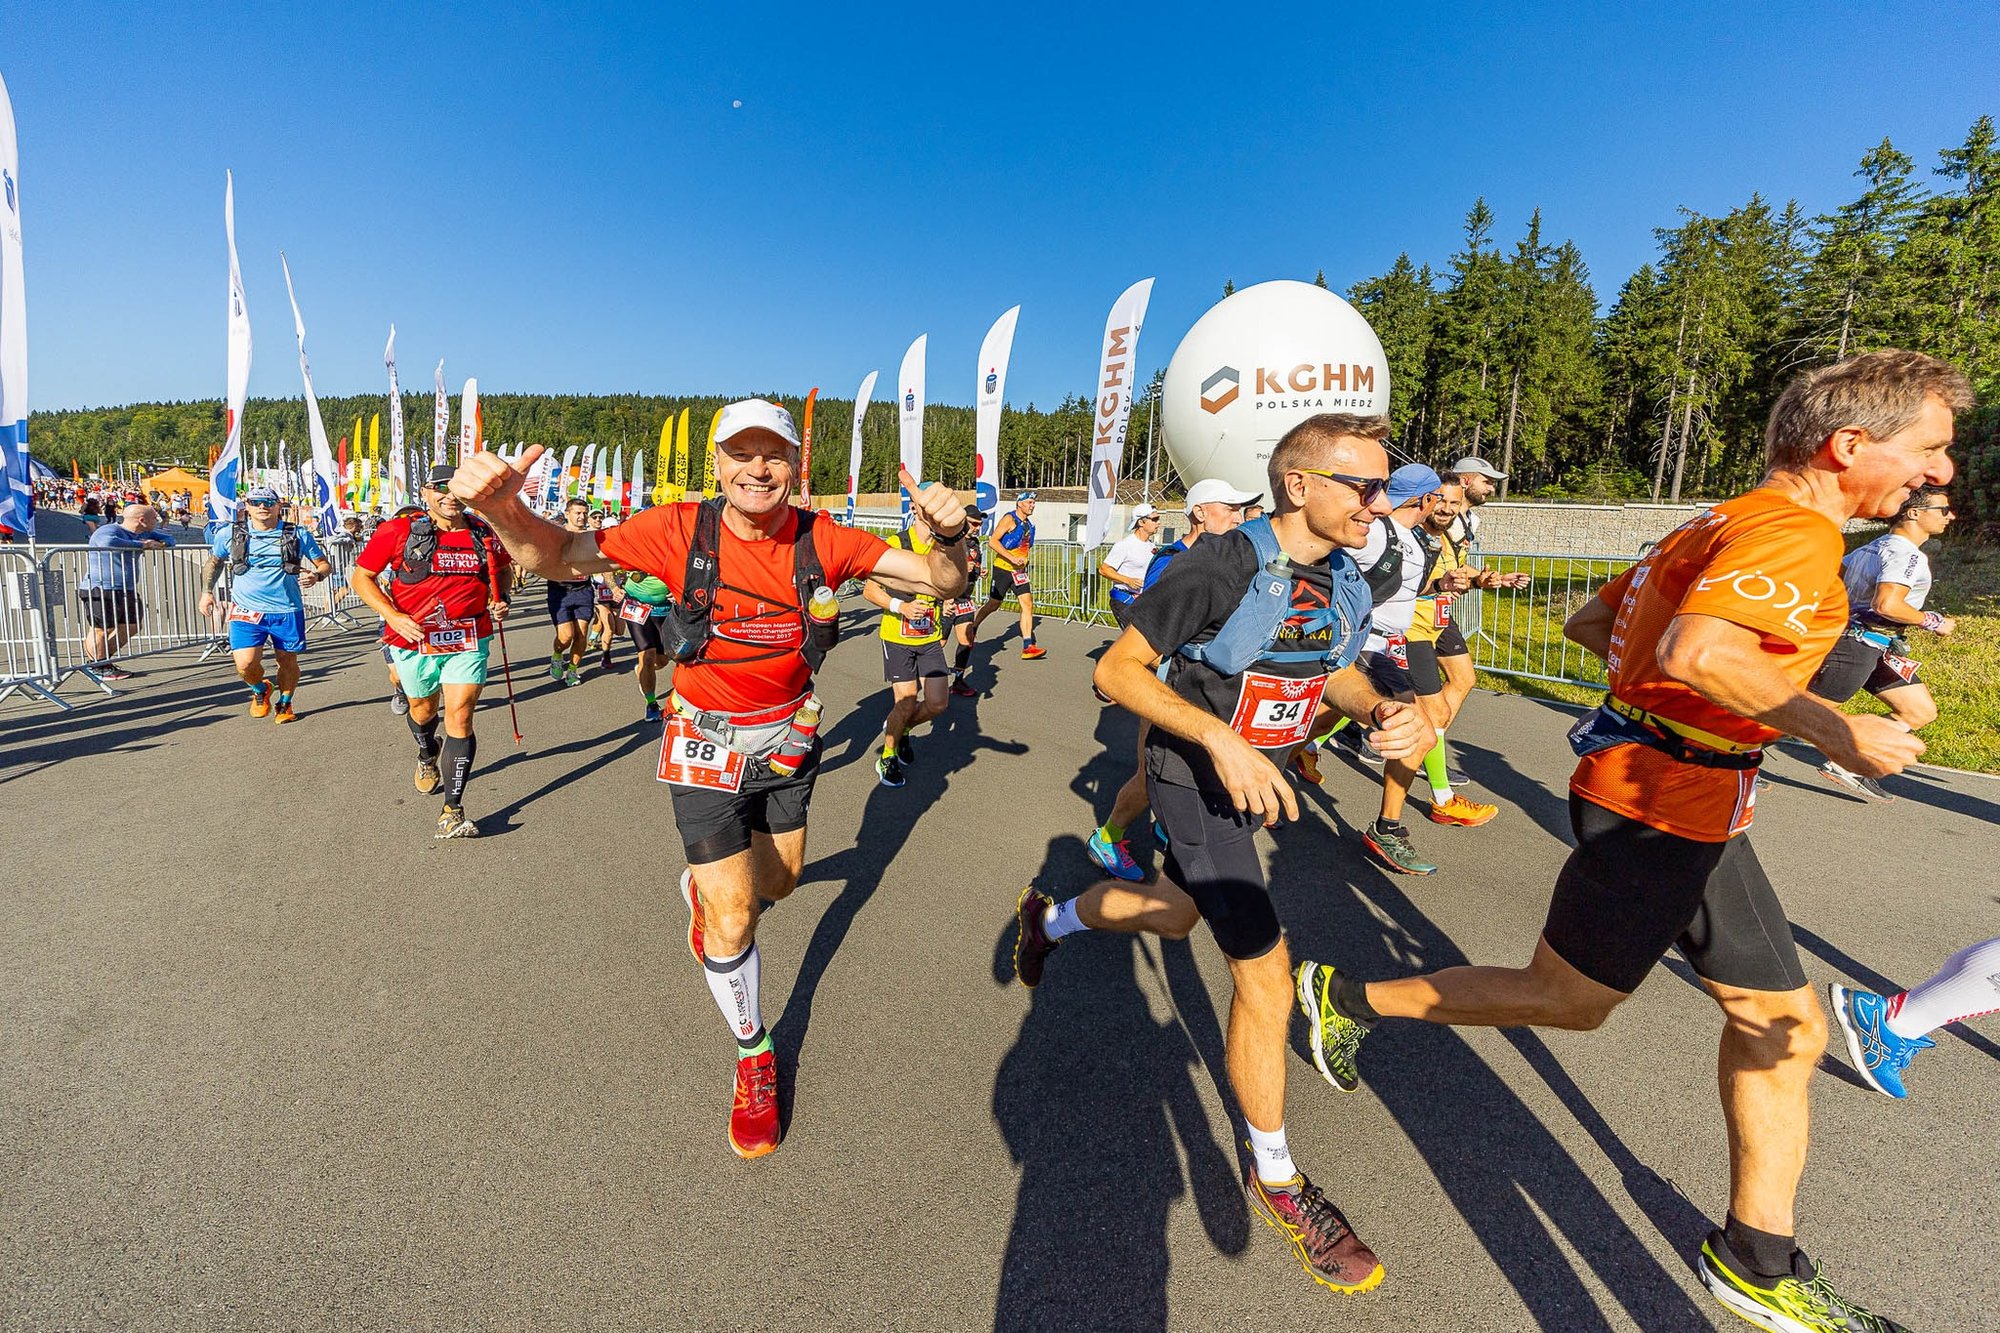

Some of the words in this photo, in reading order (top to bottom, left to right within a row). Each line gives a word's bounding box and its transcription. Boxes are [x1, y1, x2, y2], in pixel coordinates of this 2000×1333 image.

[1096, 326, 1130, 446] KGHM
[1255, 363, 1374, 395] KGHM
[1256, 399, 1323, 410] POLSKA
[1333, 397, 1373, 408] MIEDŹ
[579, 454, 591, 492] KGHM
[433, 630, 463, 642] 102
[1268, 702, 1301, 722] 34
[684, 739, 717, 762] 88
